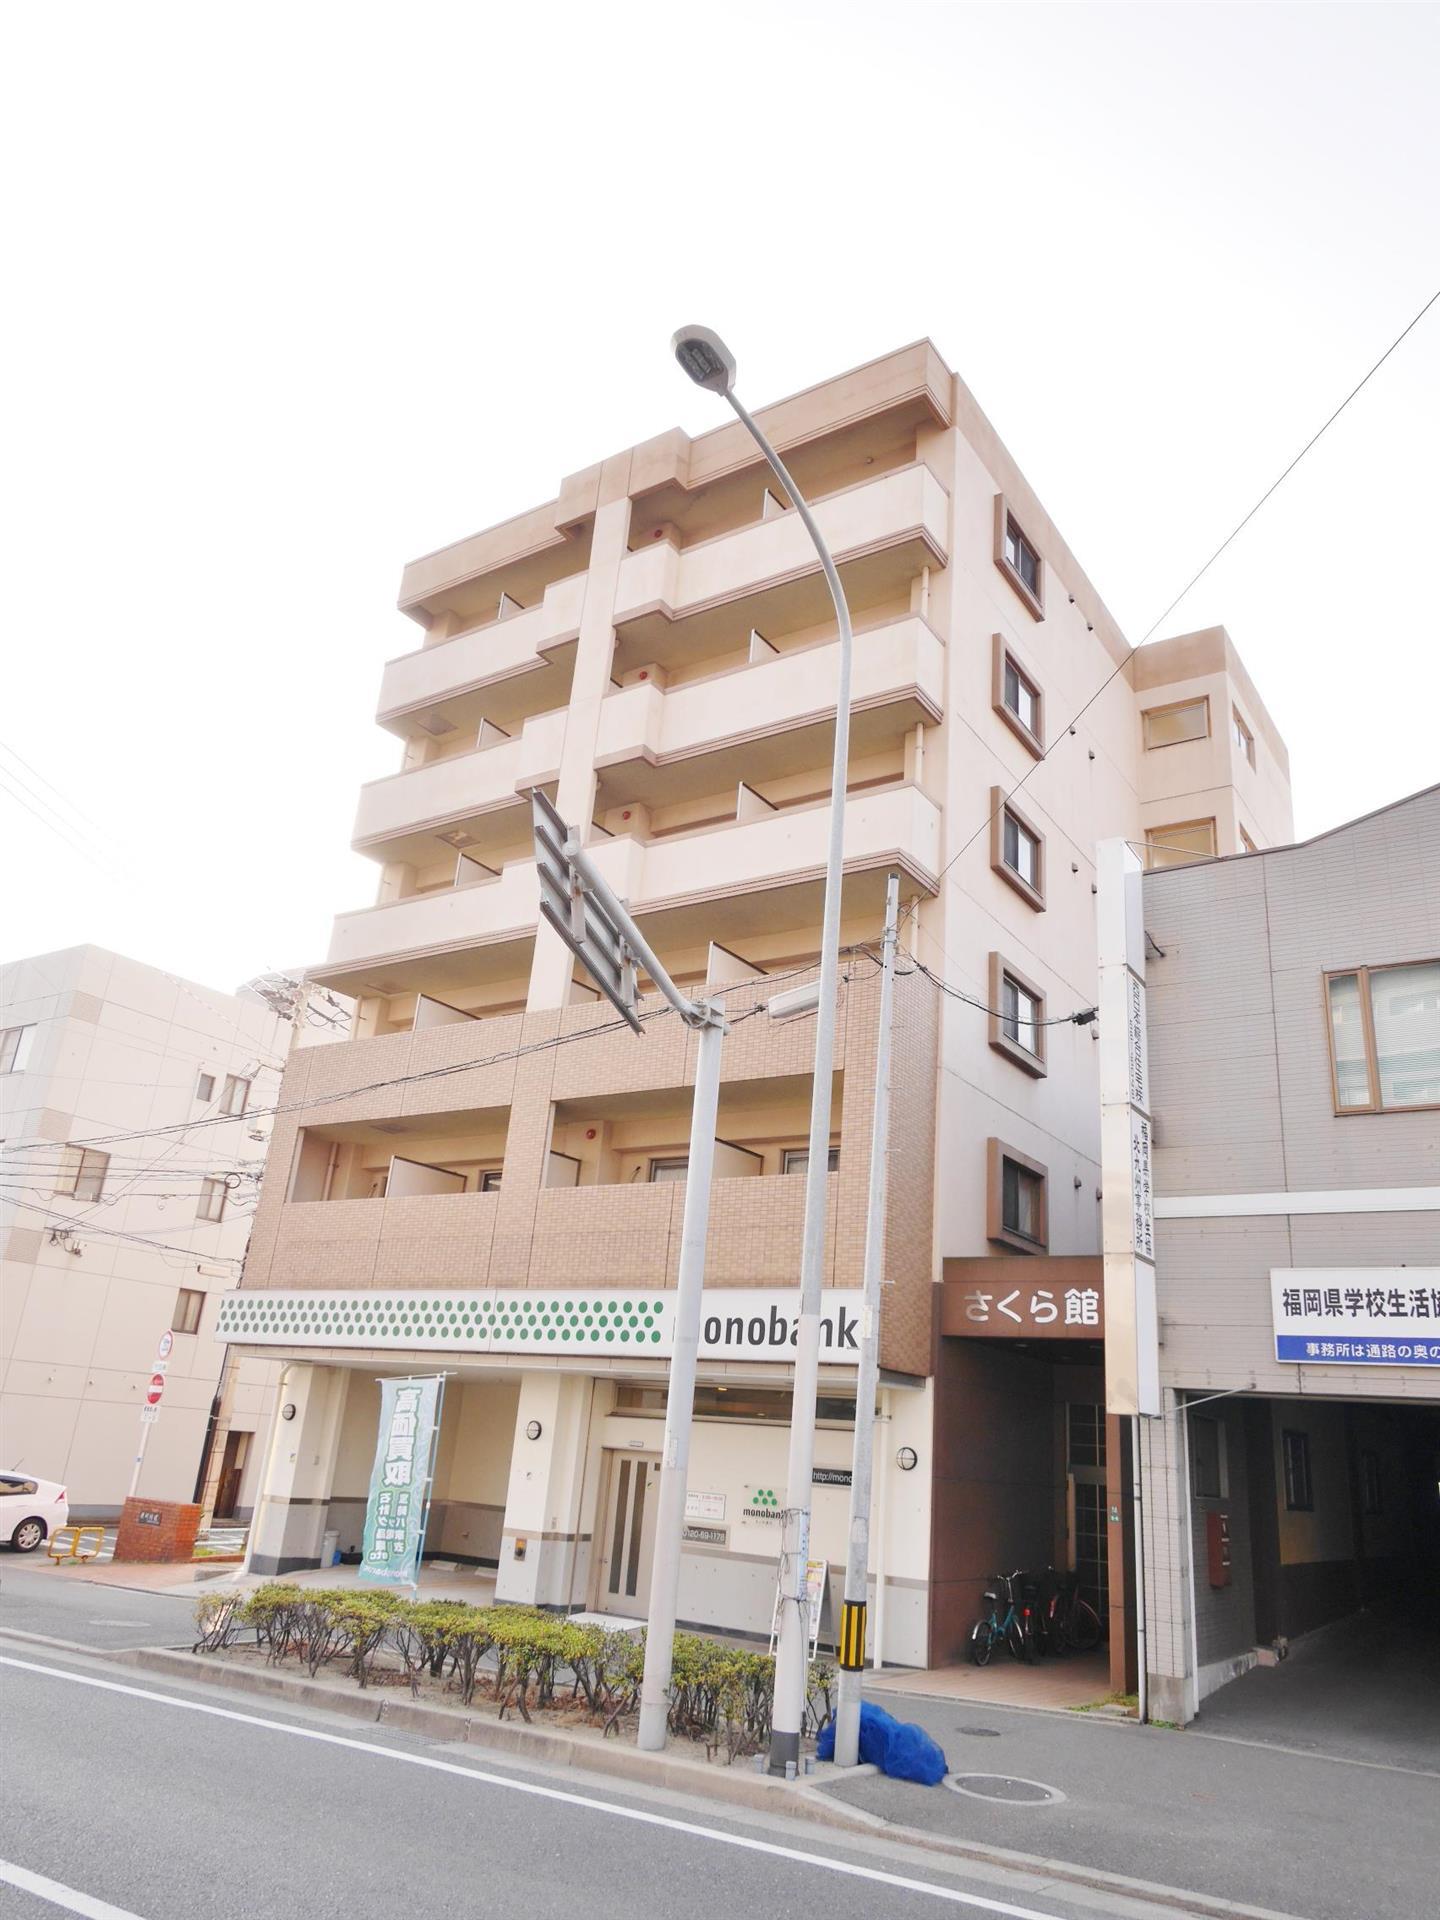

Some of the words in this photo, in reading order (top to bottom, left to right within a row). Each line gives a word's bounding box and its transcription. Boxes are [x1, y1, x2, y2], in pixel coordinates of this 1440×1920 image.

[964, 1288, 1099, 1325] さくら館
[672, 1305, 859, 1348] onobnk
[1306, 1342, 1440, 1359] 事務所は通路の奥の
